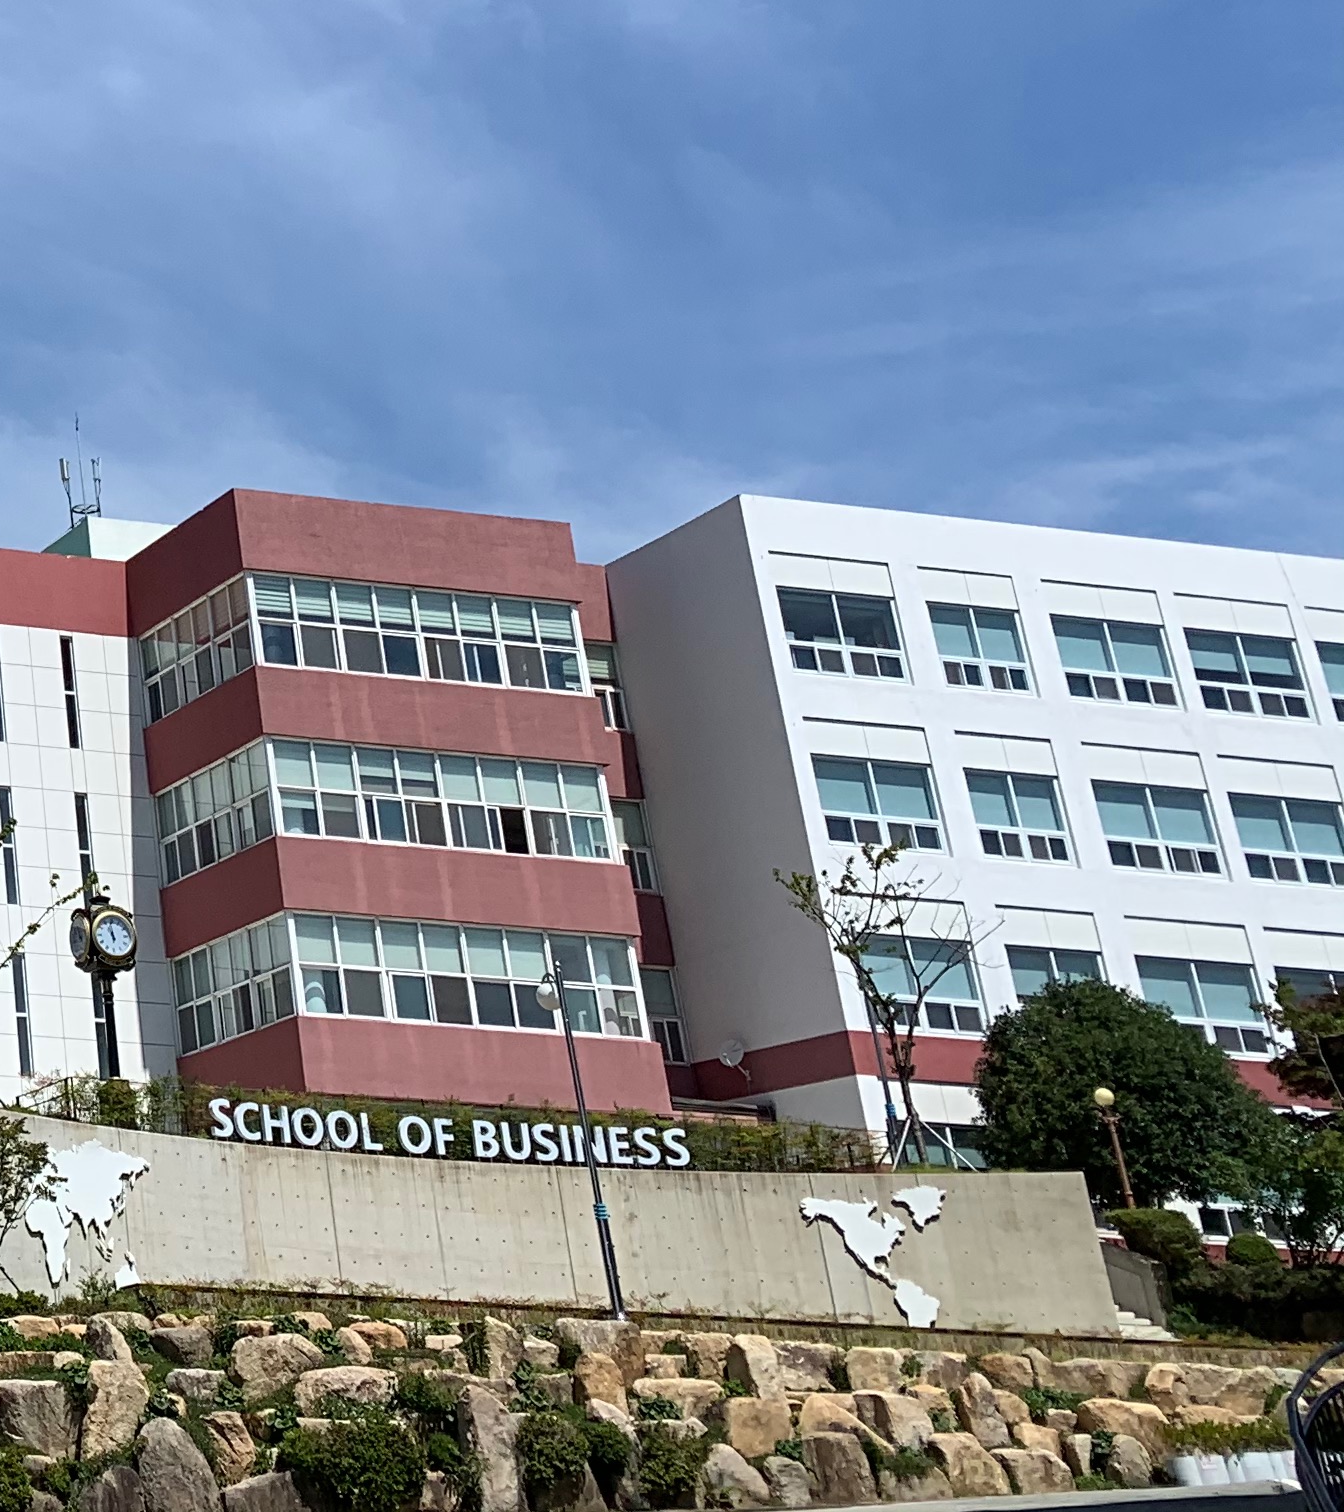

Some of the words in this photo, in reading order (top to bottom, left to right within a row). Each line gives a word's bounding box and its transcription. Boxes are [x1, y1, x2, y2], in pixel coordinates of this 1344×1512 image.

[208, 1096, 384, 1152] SCHOOL
[397, 1114, 455, 1157] OF
[472, 1119, 692, 1168] BUSINESS
